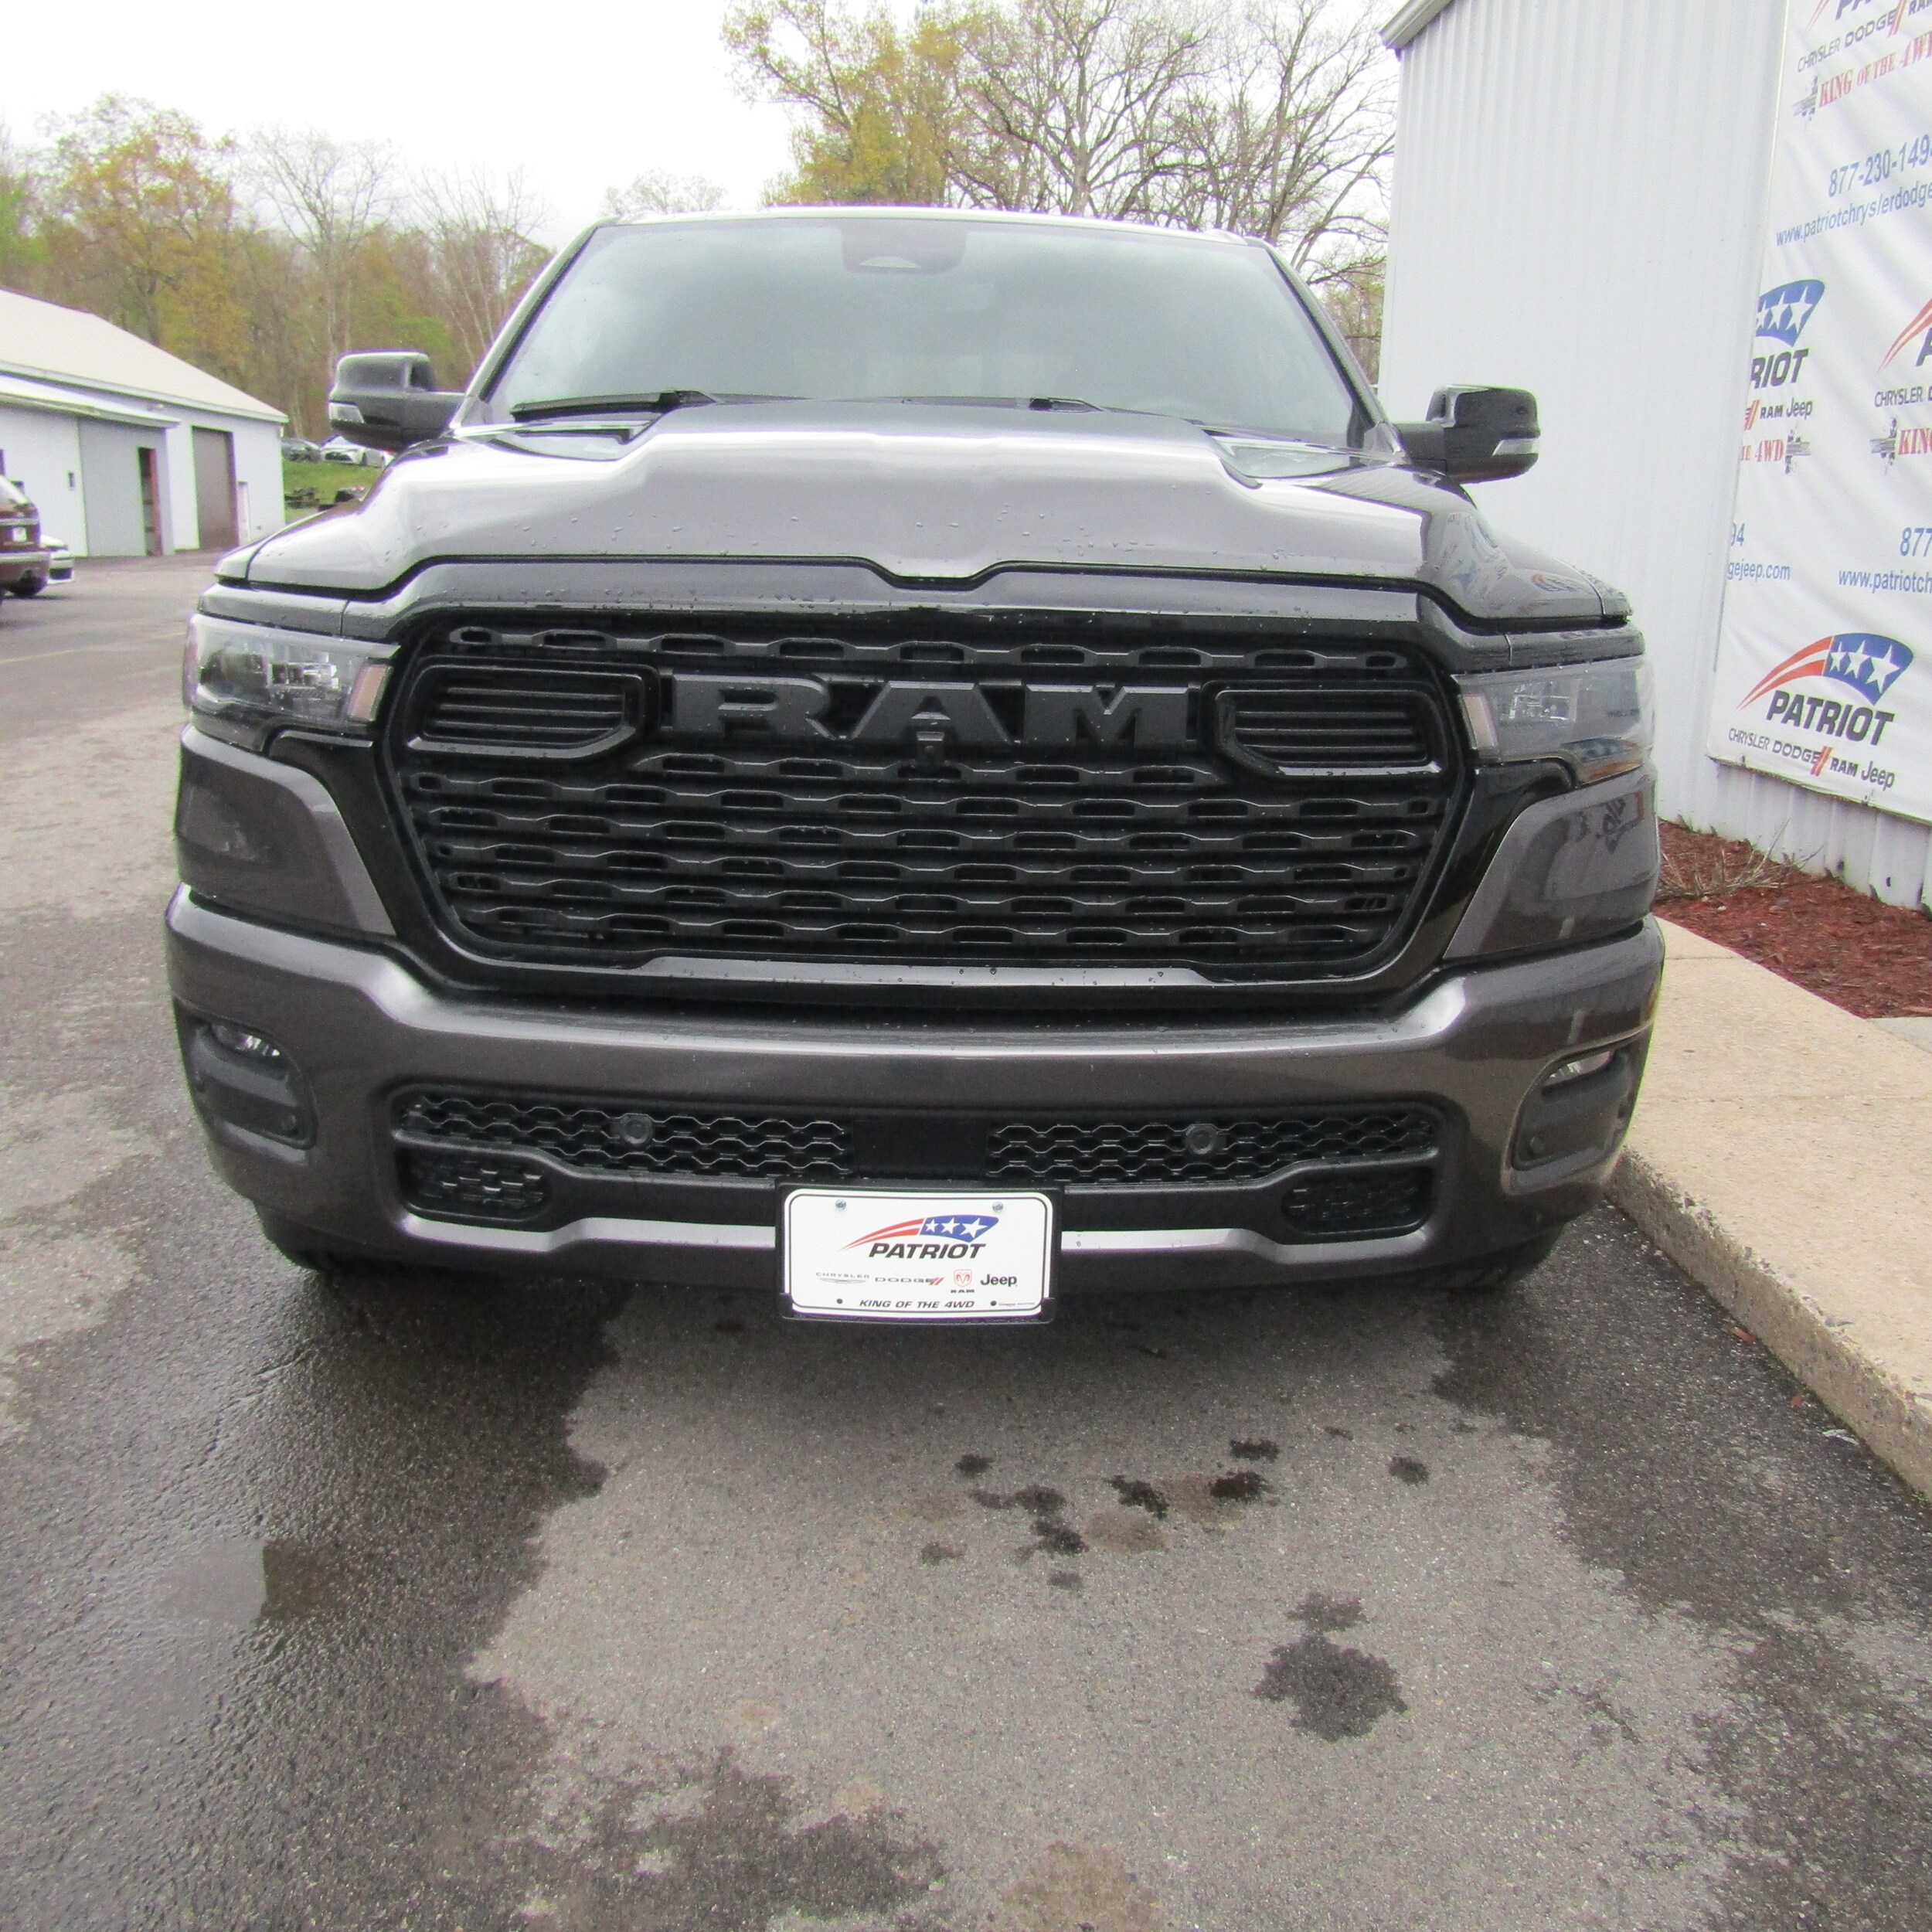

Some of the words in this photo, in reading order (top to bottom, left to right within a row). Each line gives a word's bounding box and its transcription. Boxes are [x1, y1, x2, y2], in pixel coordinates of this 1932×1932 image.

[1797, 38, 1842, 73] CHRYSLER
[1845, 9, 1897, 48] DODGE
[1819, 70, 1853, 107] KING
[1857, 63, 1871, 87] OF
[1873, 53, 1896, 79] THE
[1828, 134, 1932, 197] 877-230-149
[1760, 406, 1784, 420] RAM
[1786, 397, 1813, 420] Jeep
[1875, 386, 1923, 408] CHRYSLER
[1755, 439, 1784, 462] 4WD
[1898, 428, 1932, 455] KIN
[673, 674, 1189, 747] RAM
[1766, 690, 1895, 746] PATRIOT
[1728, 728, 1770, 750] CHRYSLER
[1772, 740, 1821, 764] DODGE
[1829, 757, 1859, 777] RAM
[1861, 760, 1895, 791] Jeep
[869, 1243, 986, 1259] PATRIOT
[980, 1274, 1017, 1287] Jeep
